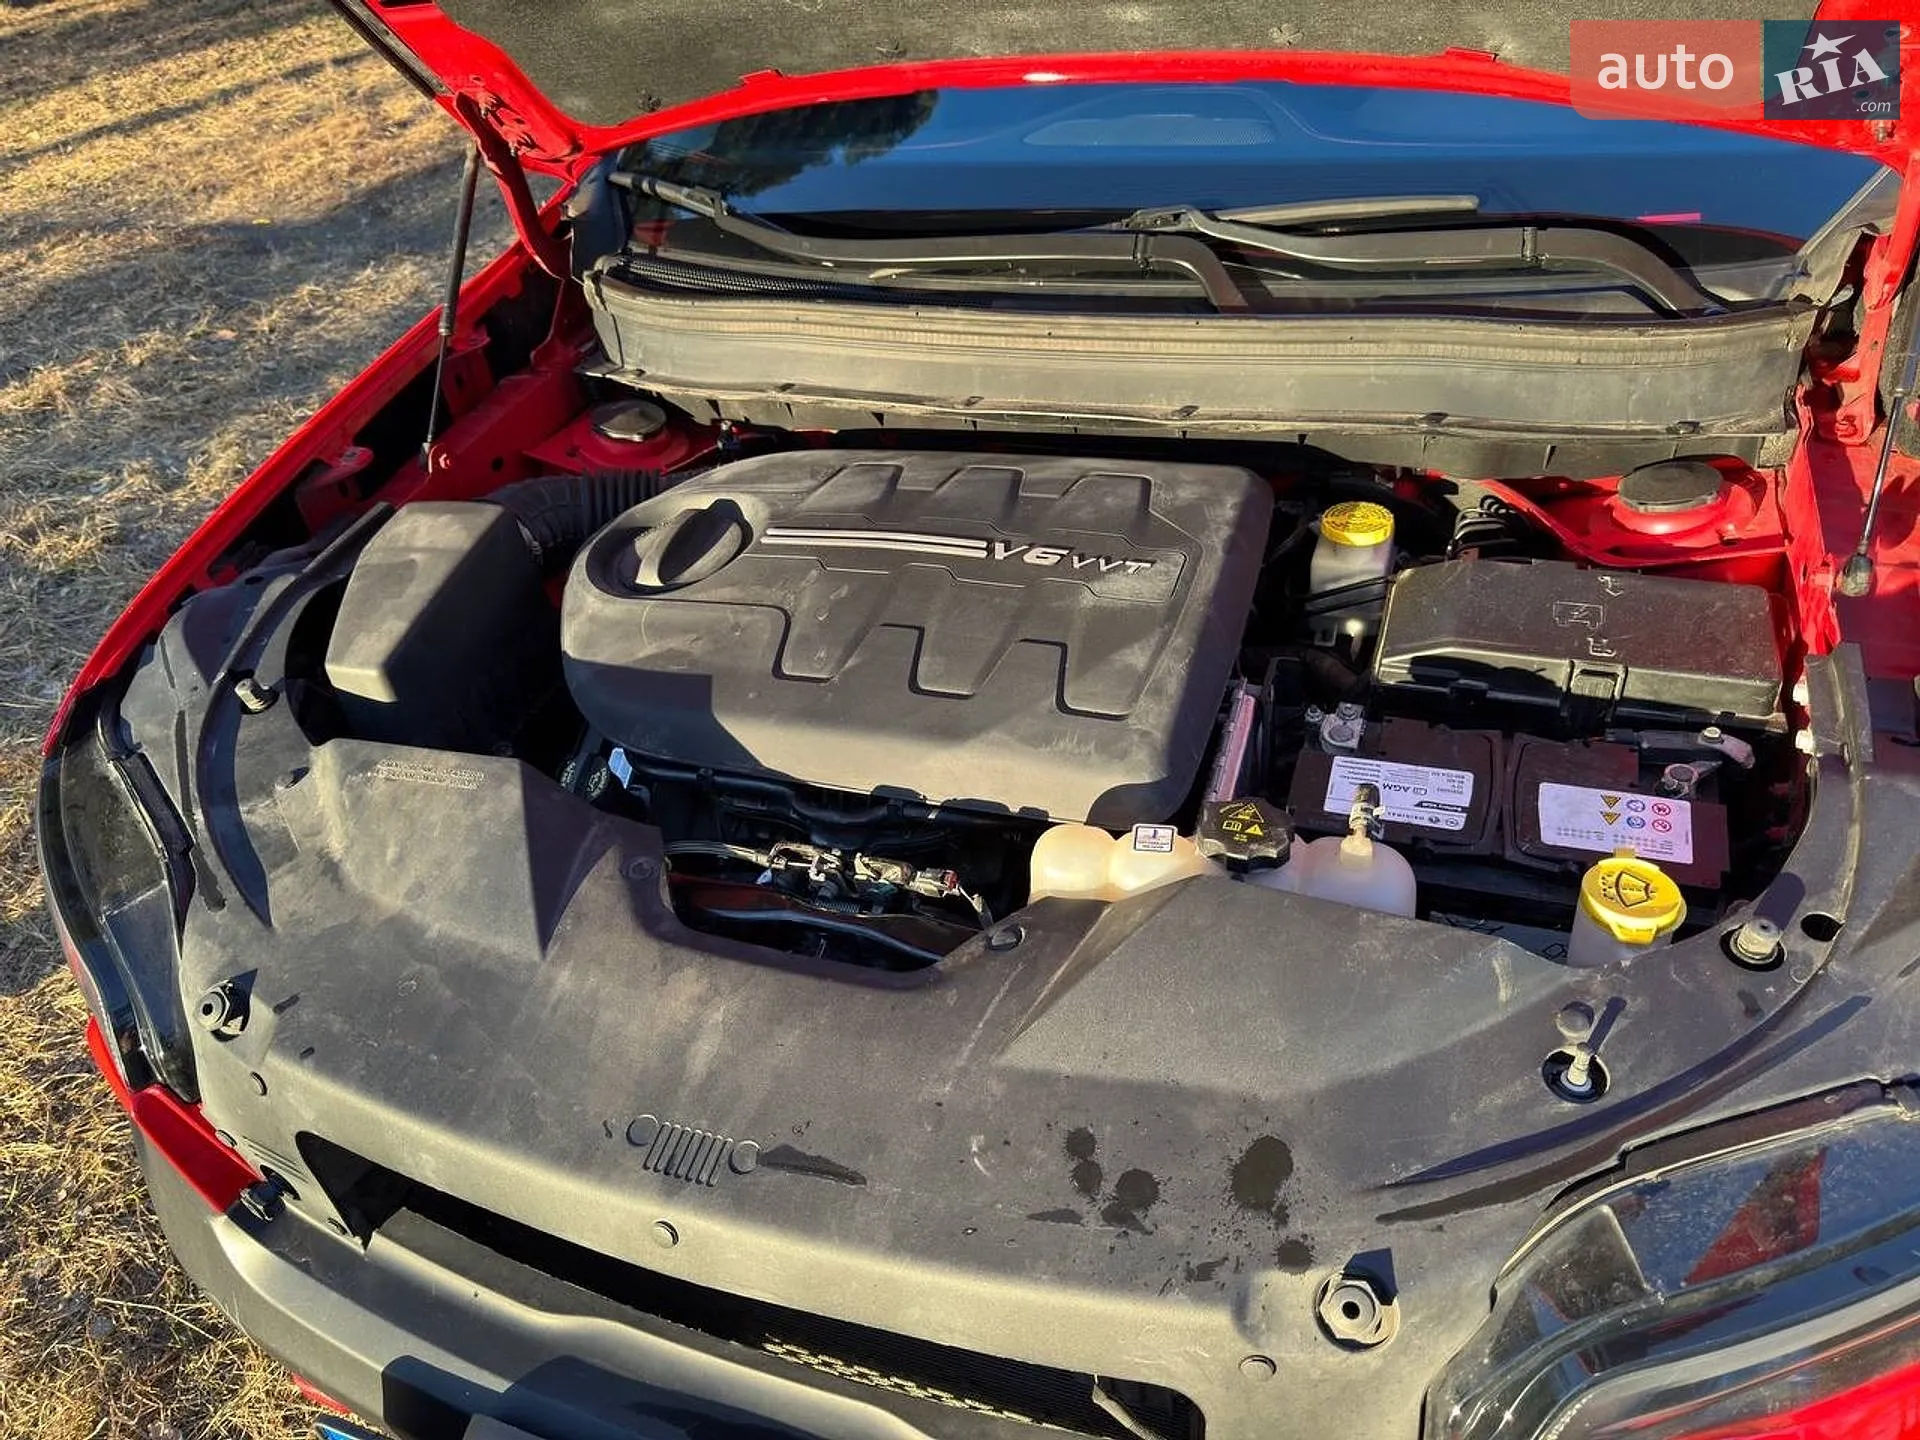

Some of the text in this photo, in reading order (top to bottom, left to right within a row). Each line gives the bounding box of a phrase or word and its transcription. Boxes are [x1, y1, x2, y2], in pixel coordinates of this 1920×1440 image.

[994, 542, 1153, 575] V6 VVT
[1383, 782, 1411, 793] AGM
